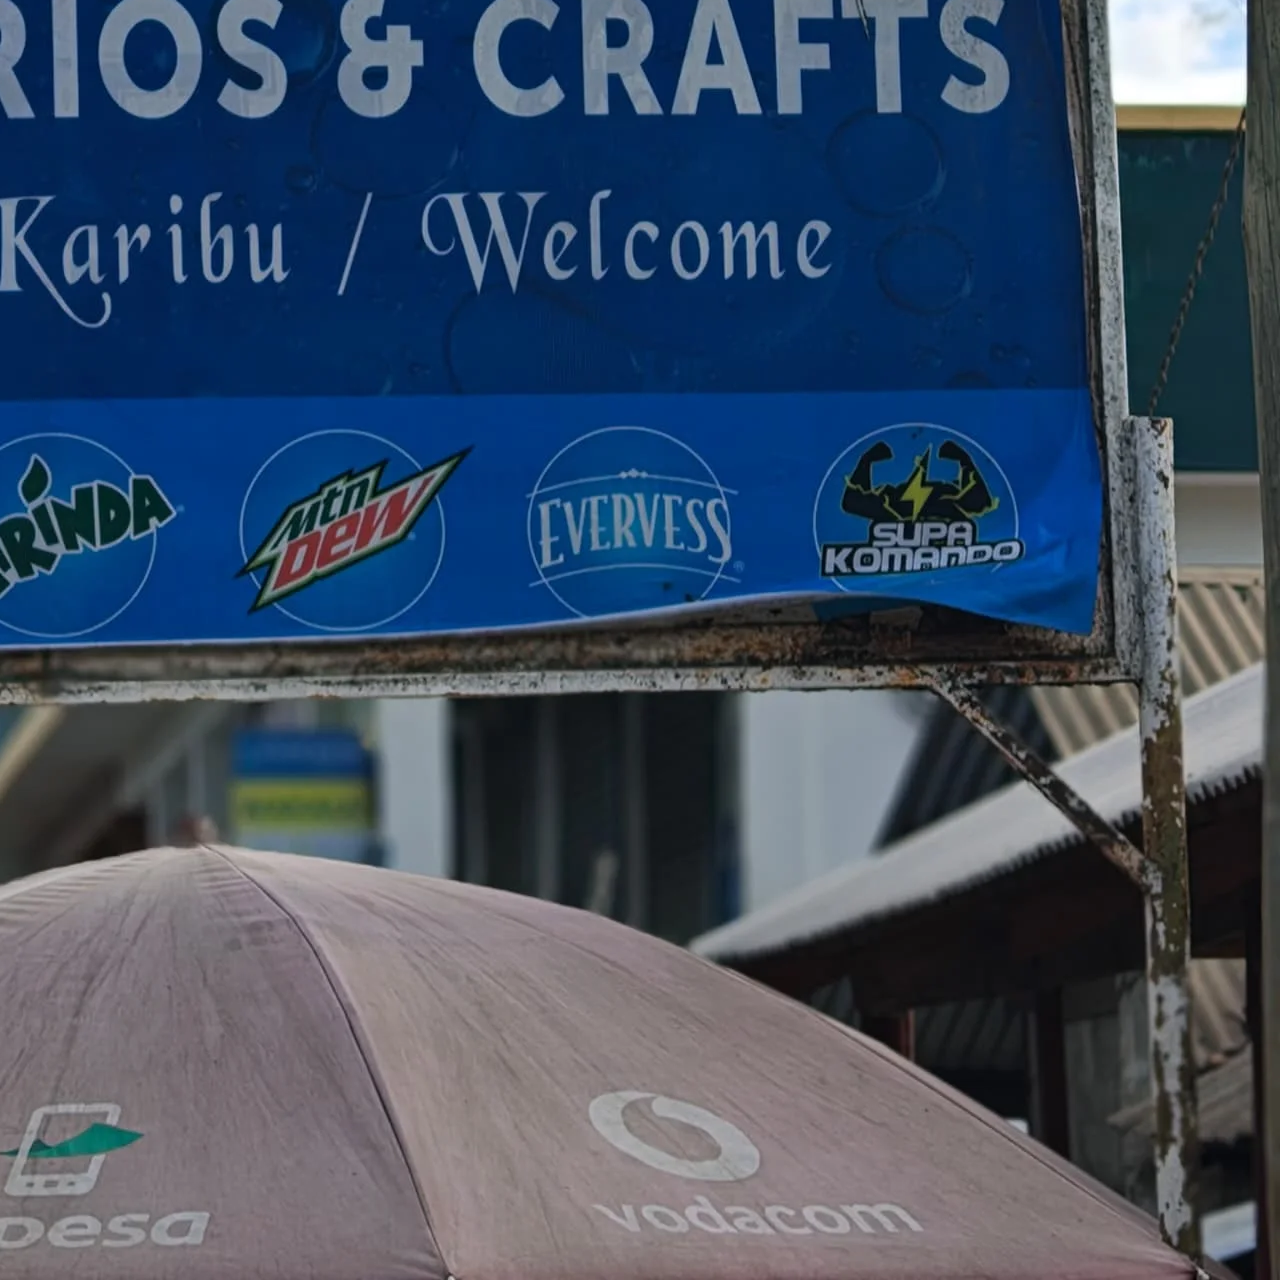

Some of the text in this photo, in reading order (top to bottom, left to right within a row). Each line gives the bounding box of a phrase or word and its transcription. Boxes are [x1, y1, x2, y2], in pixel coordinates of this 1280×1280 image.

[336, 192, 373, 296] /
[420, 189, 832, 296] Welcome
[538, 493, 732, 569] EVERVESS
[872, 521, 973, 547] SUPA
[824, 541, 1021, 574] KOMANDO
[593, 1195, 924, 1235] vodacom
